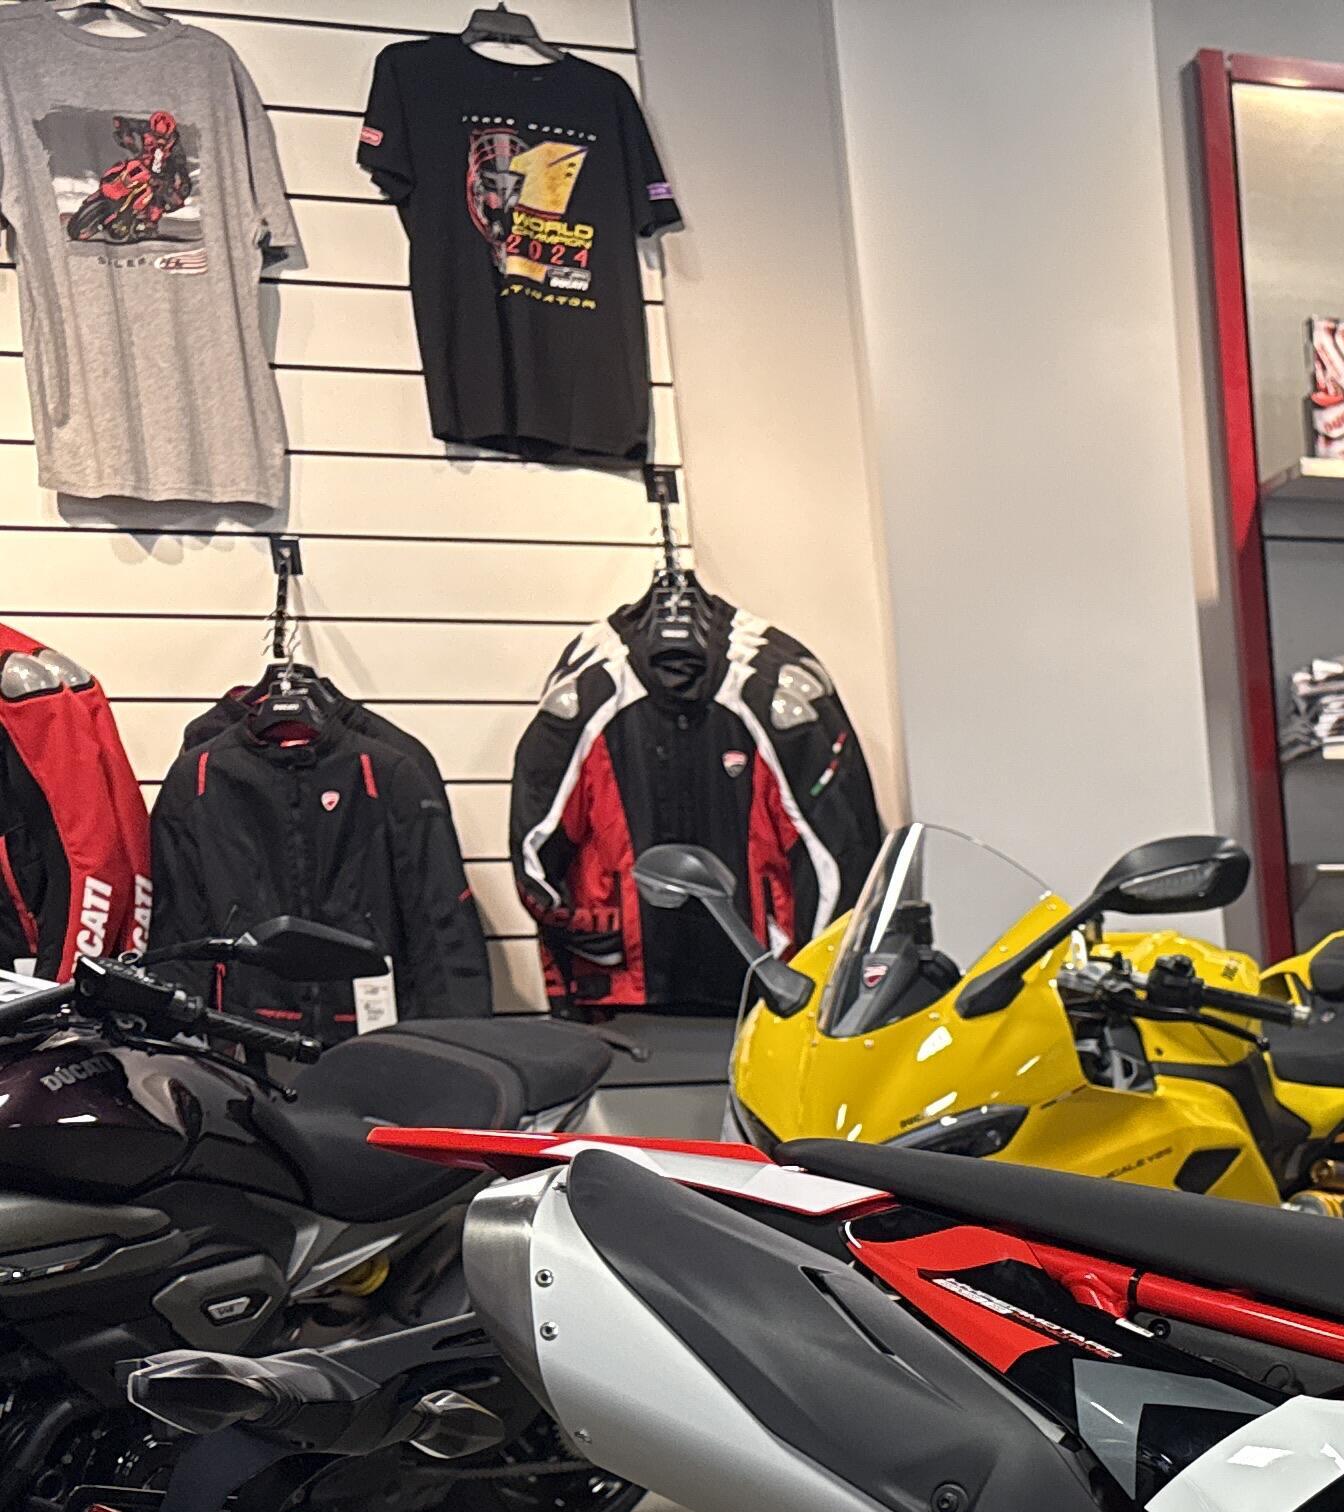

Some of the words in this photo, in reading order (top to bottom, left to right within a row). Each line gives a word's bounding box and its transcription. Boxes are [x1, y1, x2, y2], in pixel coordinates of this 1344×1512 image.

[513, 212, 594, 240] WORLD
[506, 233, 589, 268] 2024
[71, 875, 113, 975] CATI
[132, 873, 154, 954] CATI
[40, 1052, 114, 1092] DUCATI
